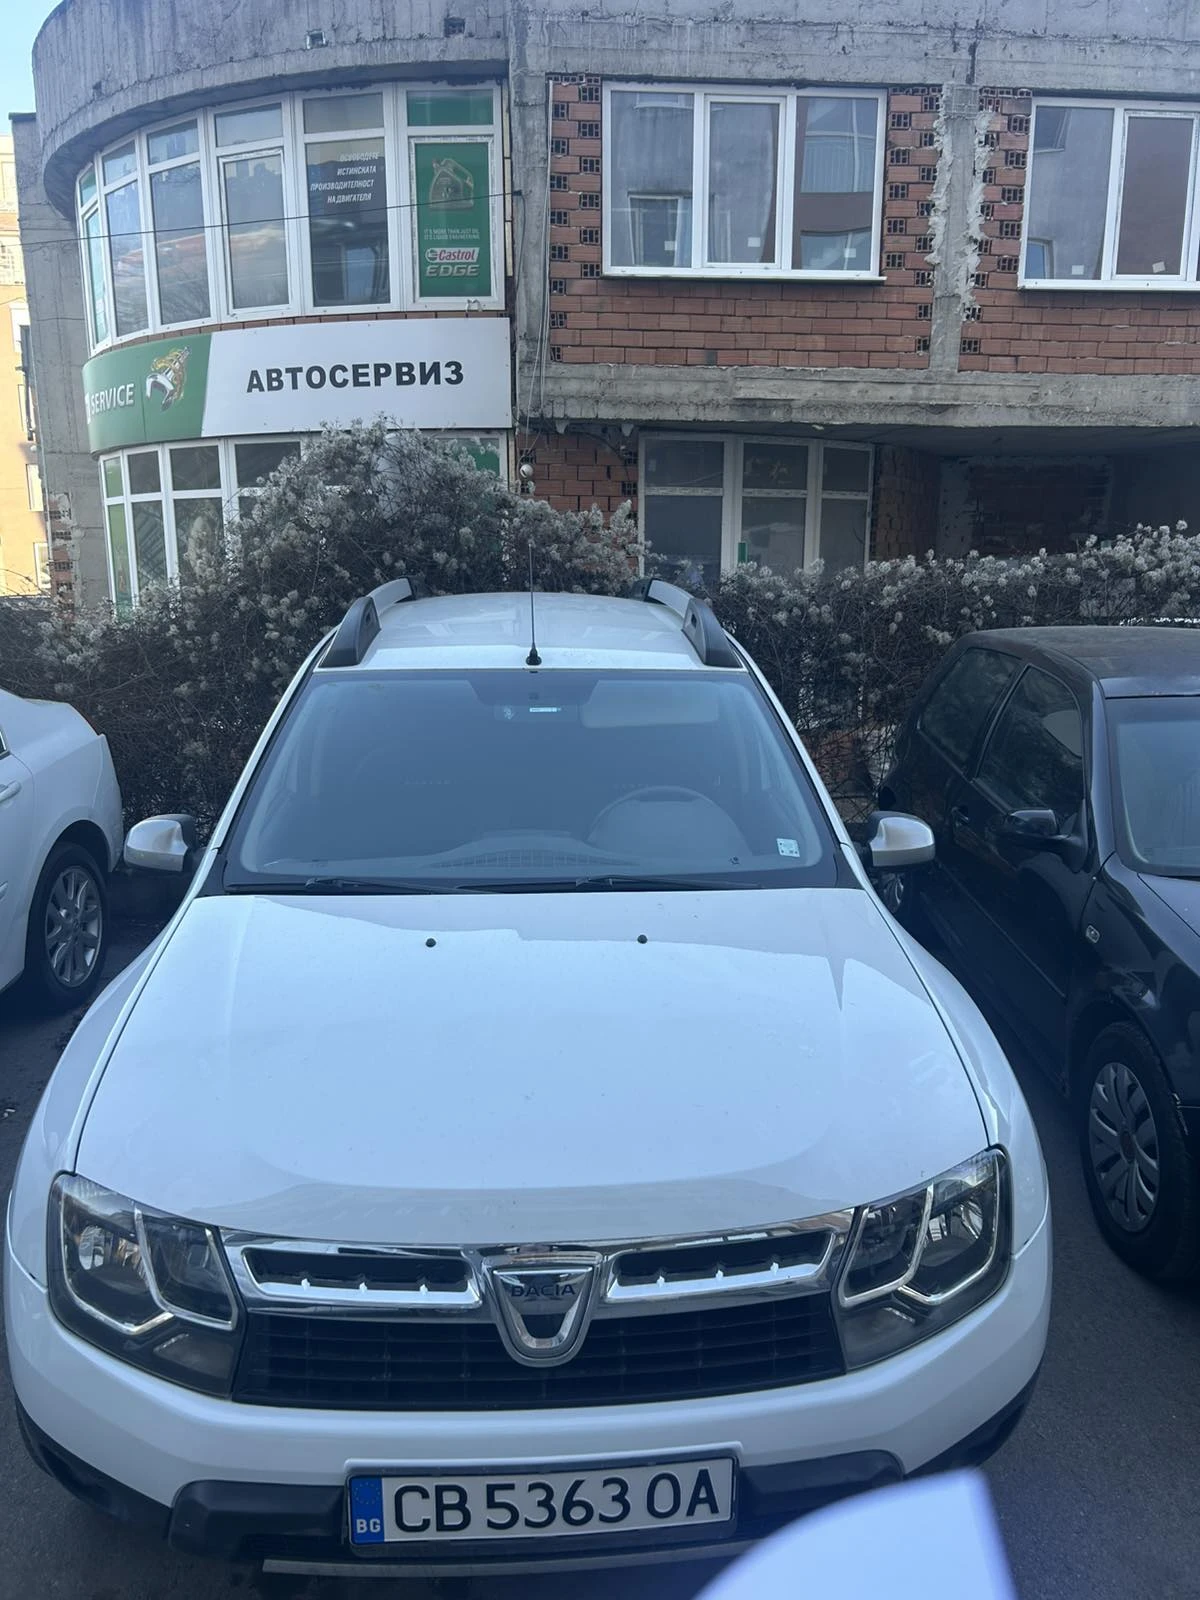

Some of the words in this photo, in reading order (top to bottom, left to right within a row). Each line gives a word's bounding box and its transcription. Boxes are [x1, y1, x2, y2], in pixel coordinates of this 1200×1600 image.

[337, 166, 377, 176] ИСТИНСКАТА
[310, 180, 375, 191] ПРОИЗВОДИТЕЛНОСТ
[336, 193, 372, 203] ДВИГАТЕЛЯ
[439, 249, 475, 261] Castrol
[426, 265, 480, 277] EDGE
[246, 360, 465, 393] АВТОСЕРВИЗ
[91, 383, 135, 415] SERVICE
[511, 1284, 576, 1297] DACIA
[356, 1519, 381, 1533] BG
